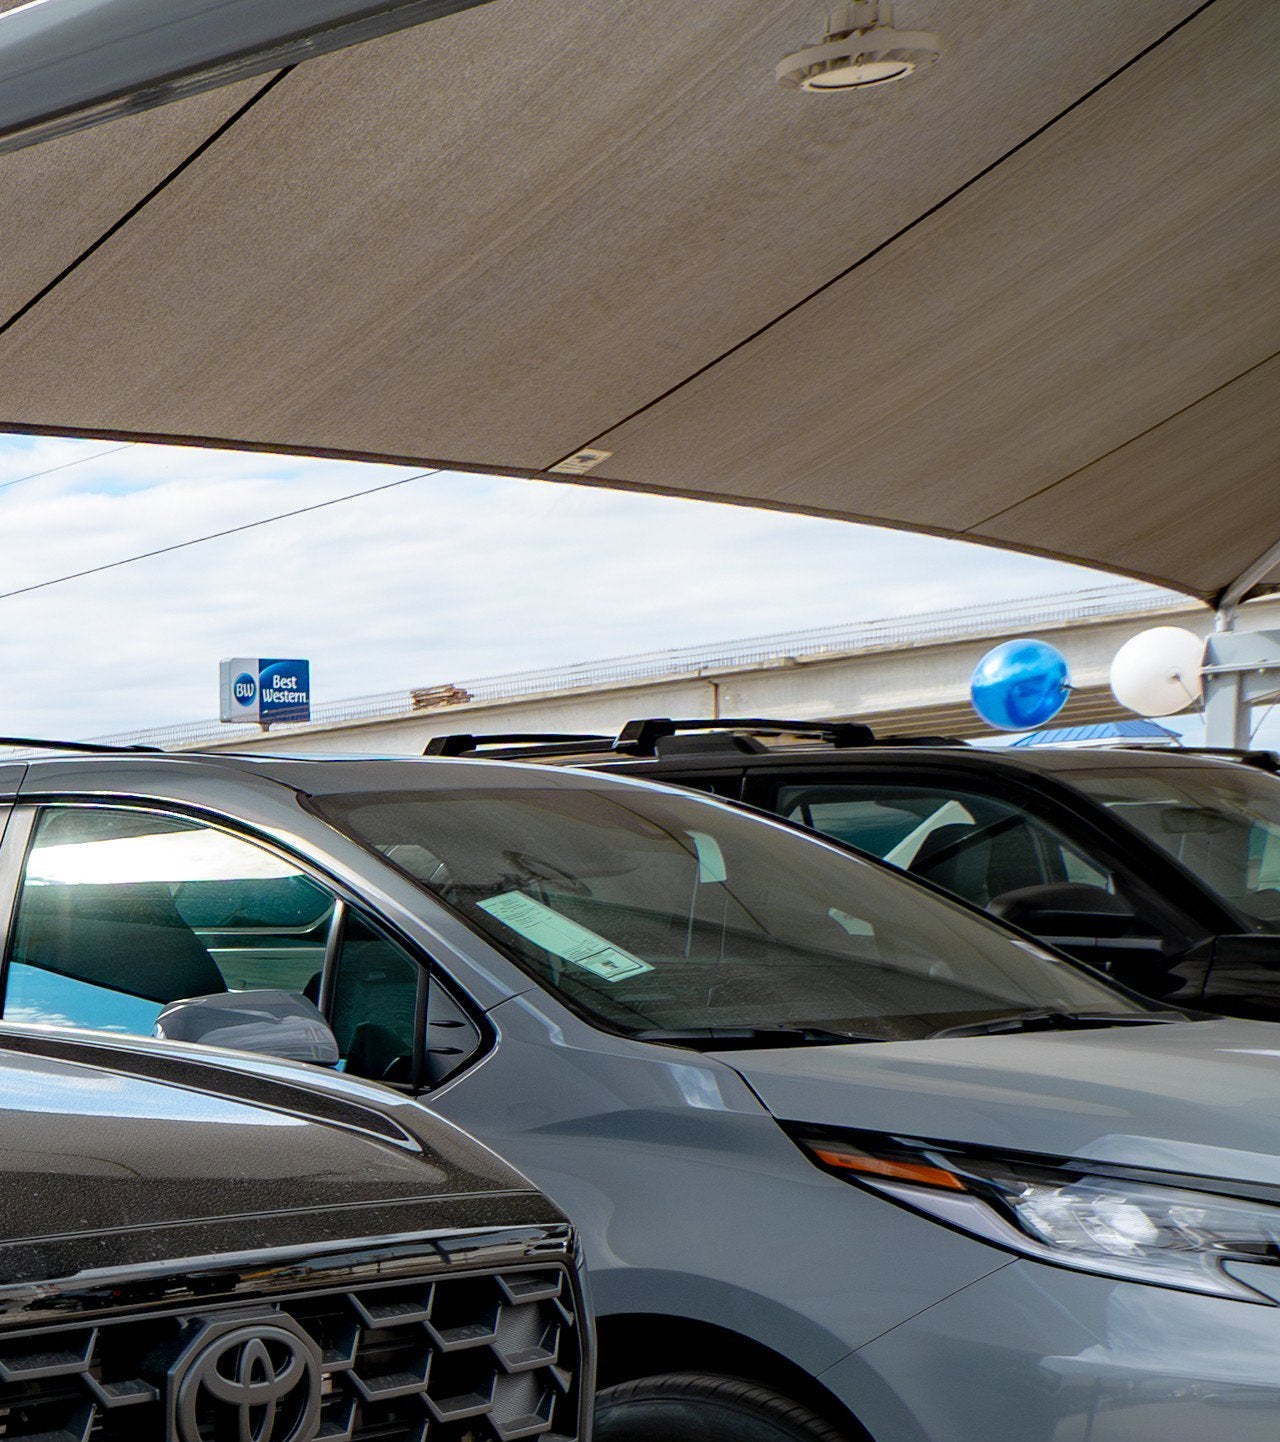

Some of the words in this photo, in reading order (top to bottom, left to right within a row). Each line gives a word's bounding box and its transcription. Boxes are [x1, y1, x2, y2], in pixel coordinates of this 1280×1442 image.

[272, 674, 298, 690] Best
[236, 683, 255, 698] BW
[262, 688, 307, 704] Western
